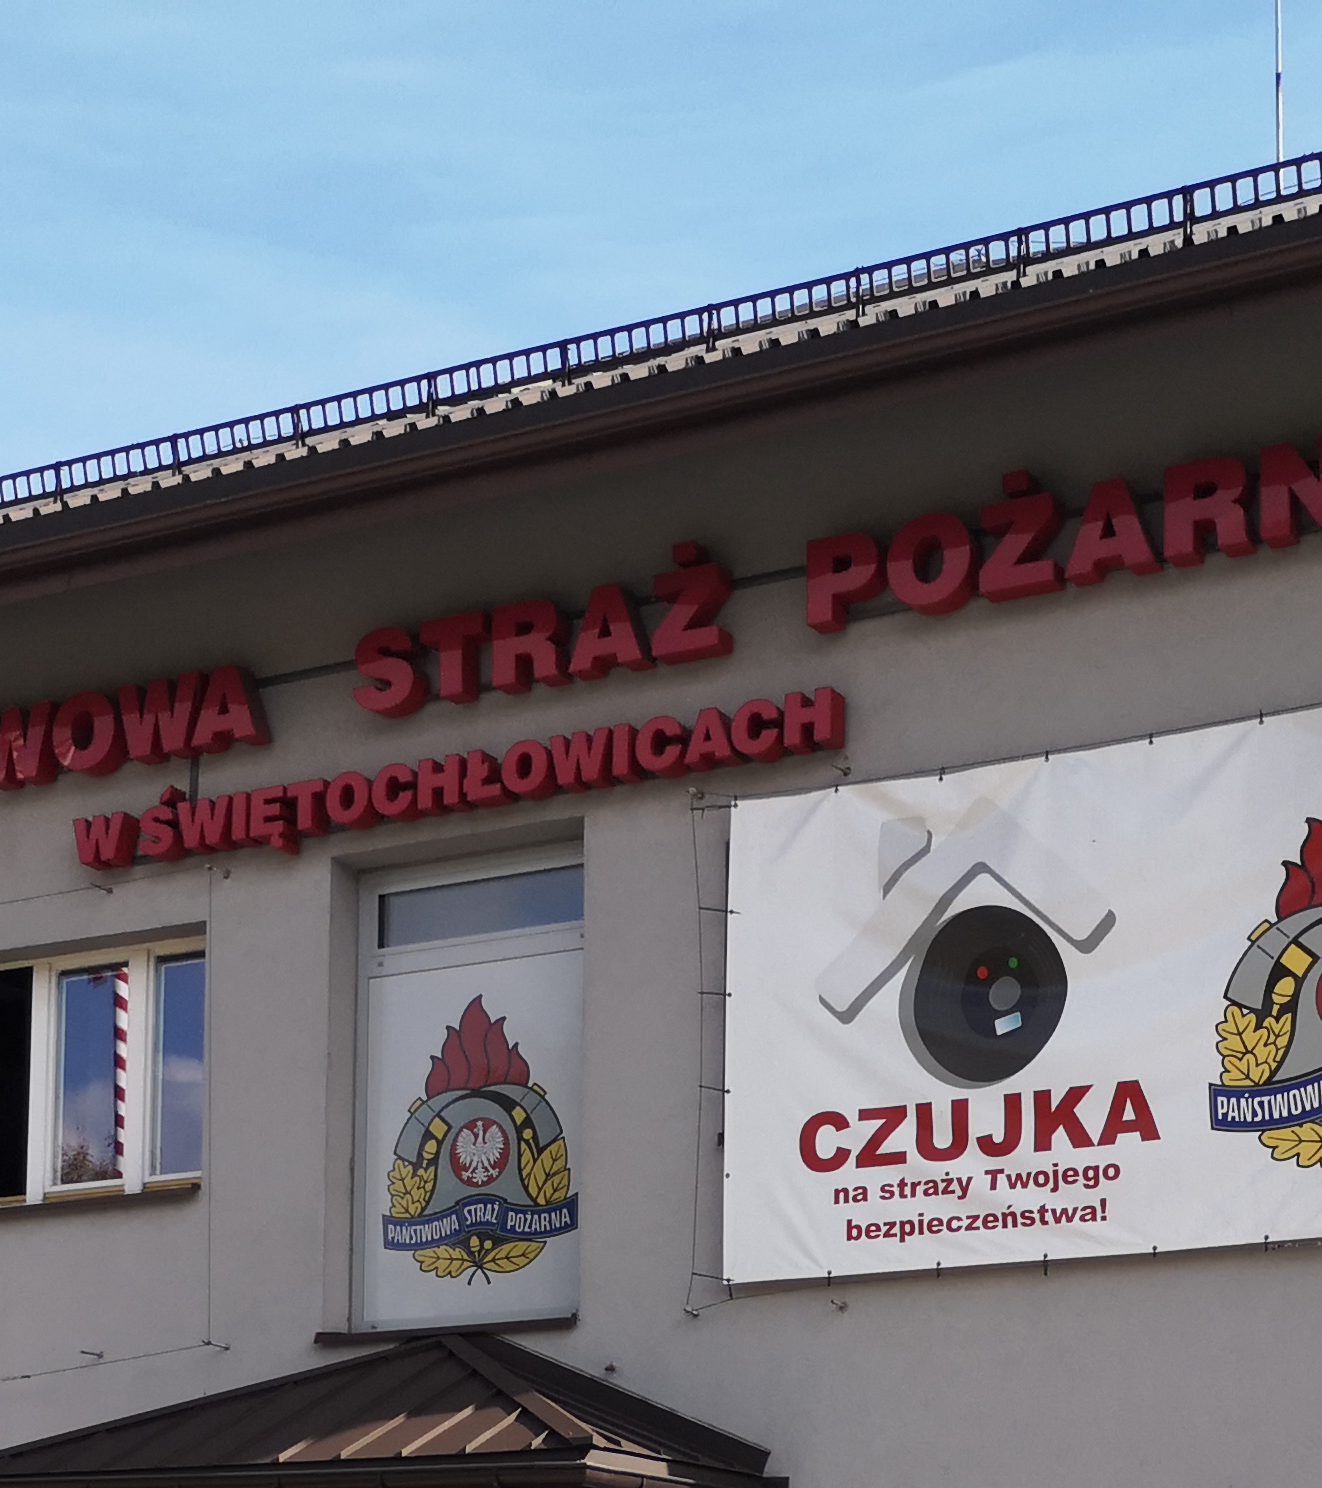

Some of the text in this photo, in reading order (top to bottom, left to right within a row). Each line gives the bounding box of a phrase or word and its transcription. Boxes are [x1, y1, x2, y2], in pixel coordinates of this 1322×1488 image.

[353, 541, 733, 718] STRAŻ
[74, 686, 846, 870] W ŚWIĘTOCHŁOWICACH
[799, 1080, 1161, 1173] CZUJKA
[834, 1163, 1121, 1205] na straży Twojego
[388, 1202, 571, 1244] PAŃSTWOWA STRAŻ POŻARNA
[846, 1198, 1108, 1243] bezpieczeństwa!
